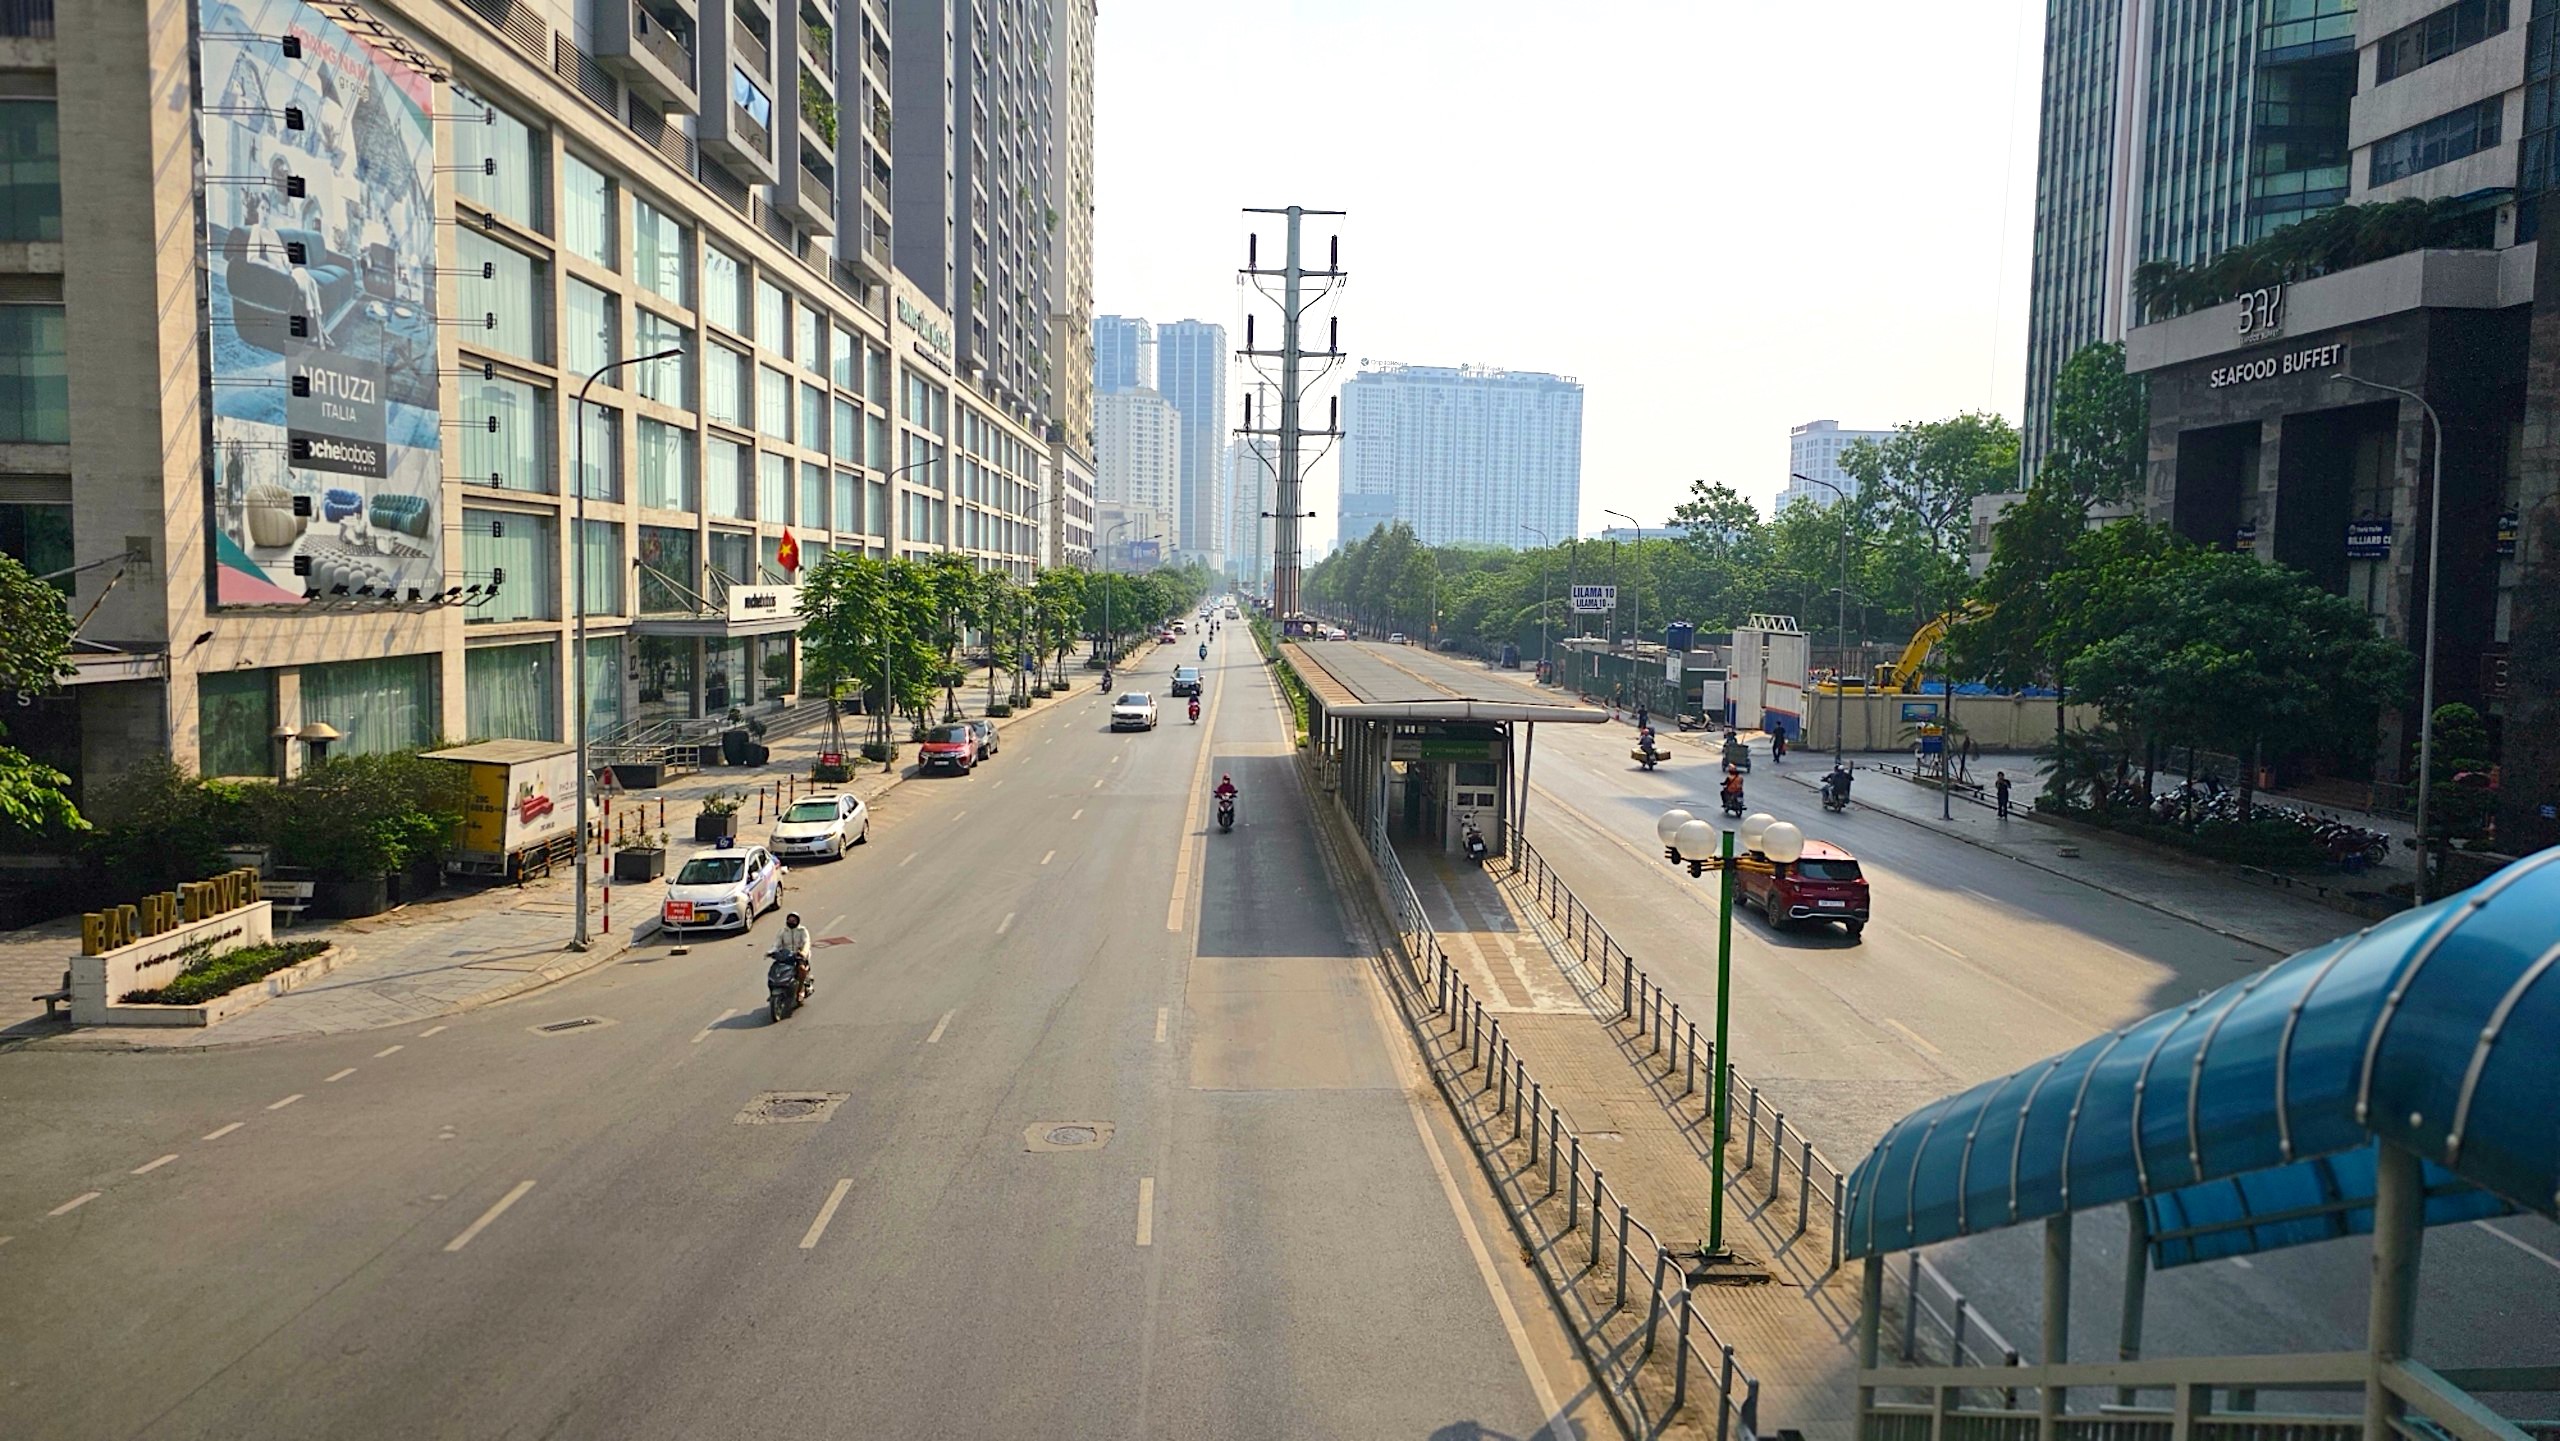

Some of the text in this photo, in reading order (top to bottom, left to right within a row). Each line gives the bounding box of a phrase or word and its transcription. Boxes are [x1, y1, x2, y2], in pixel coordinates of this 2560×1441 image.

[2210, 343, 2341, 389] SEAFOOD BUFFET
[321, 402, 357, 423] ITALIA
[308, 439, 376, 465] ochebobois
[1573, 587, 1615, 598] LILAMA 10
[1576, 599, 1598, 607] LILAMA
[82, 904, 138, 956] BAC
[141, 891, 179, 937] HA
[181, 866, 260, 923] TOWER
